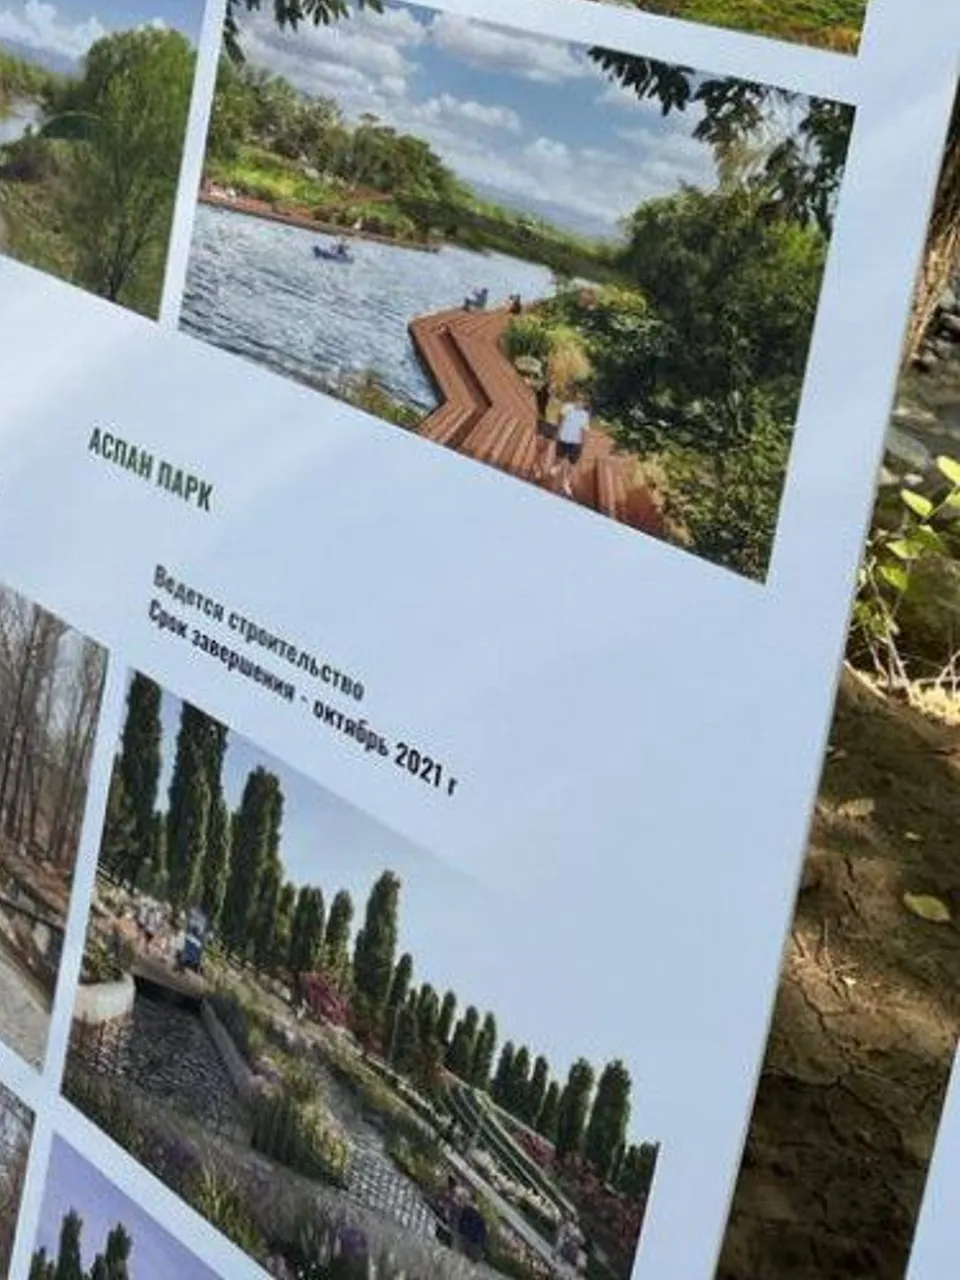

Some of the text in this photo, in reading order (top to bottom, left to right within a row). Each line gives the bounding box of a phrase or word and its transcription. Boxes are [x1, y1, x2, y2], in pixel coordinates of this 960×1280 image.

[88, 426, 214, 512] АСПАН ПАРК
[148, 598, 189, 640] Срок
[191, 628, 296, 703] завершения
[312, 698, 390, 758] октябрь
[394, 741, 444, 789] 2021
[446, 776, 459, 797] г
[153, 563, 366, 702] Ведется строительство
